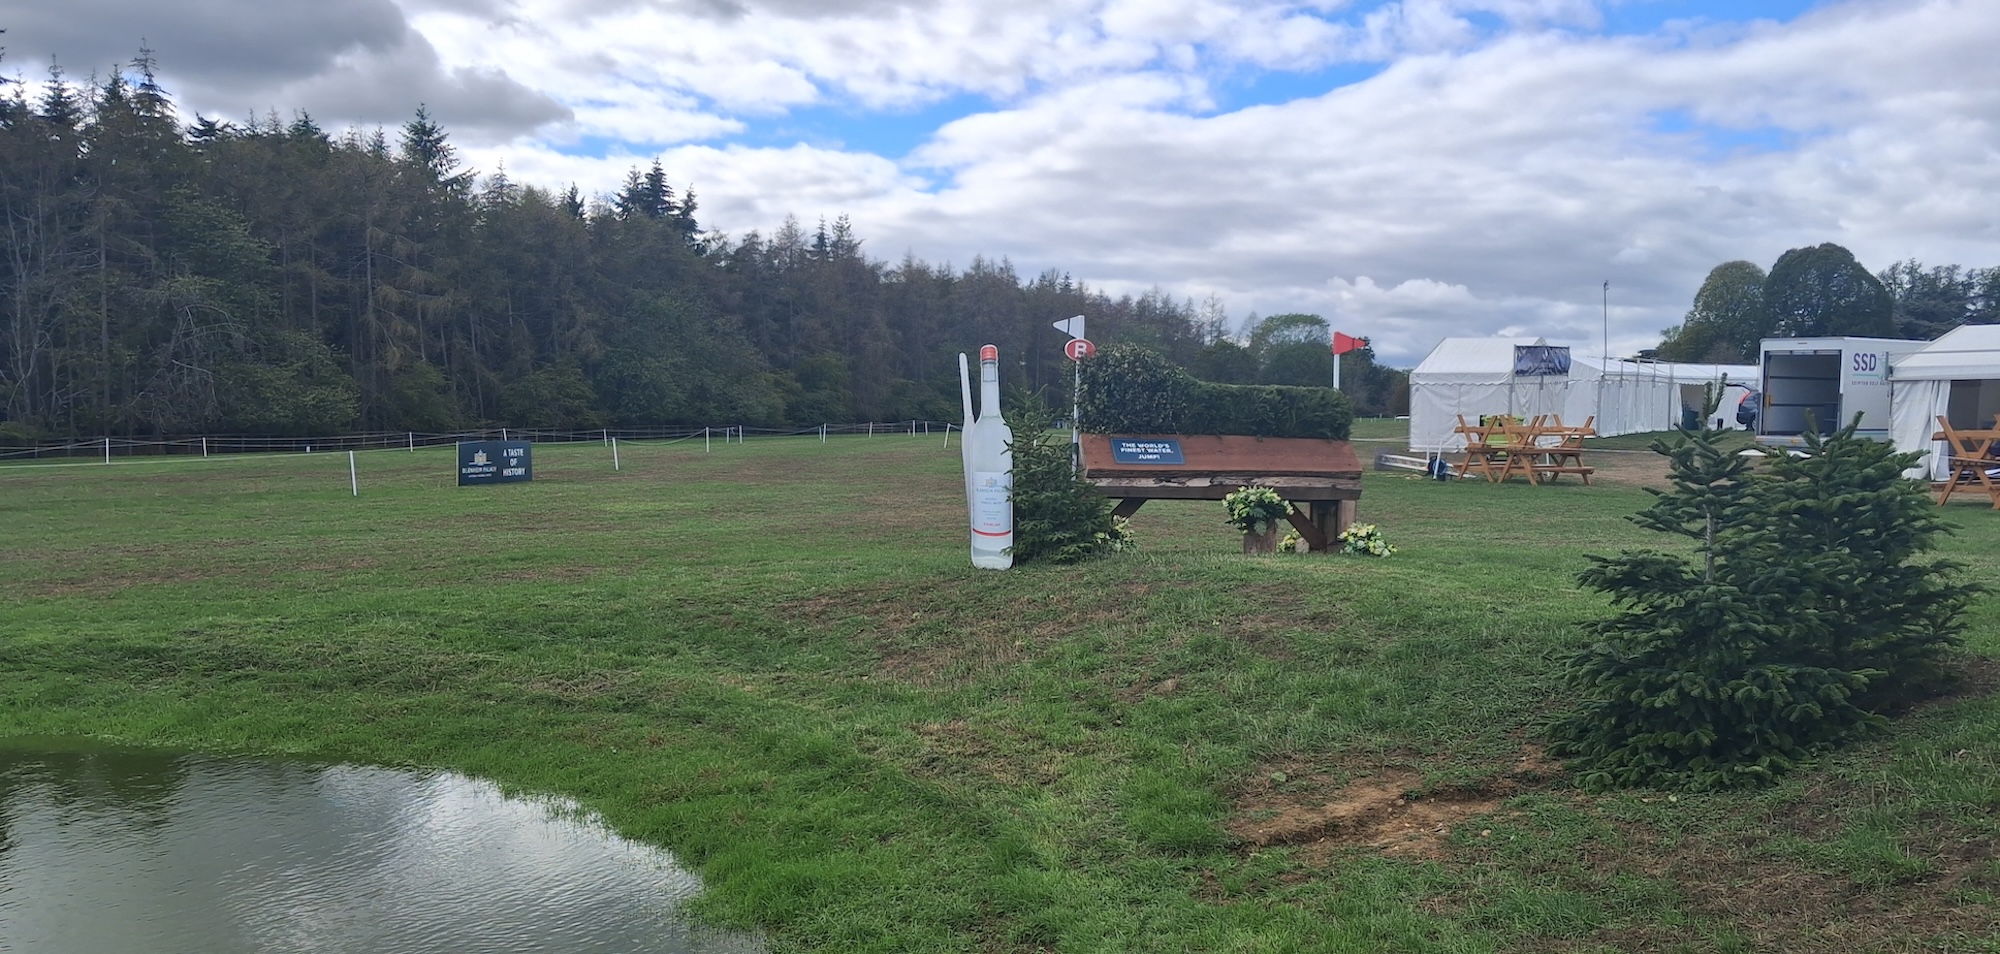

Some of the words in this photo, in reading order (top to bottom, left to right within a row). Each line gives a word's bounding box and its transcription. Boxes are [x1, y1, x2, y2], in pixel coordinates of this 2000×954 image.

[1853, 352, 1877, 372] SSD
[502, 449, 507, 457] A
[508, 448, 524, 456] TASTE
[510, 458, 517, 466] OF
[502, 468, 525, 476] HISTORY
